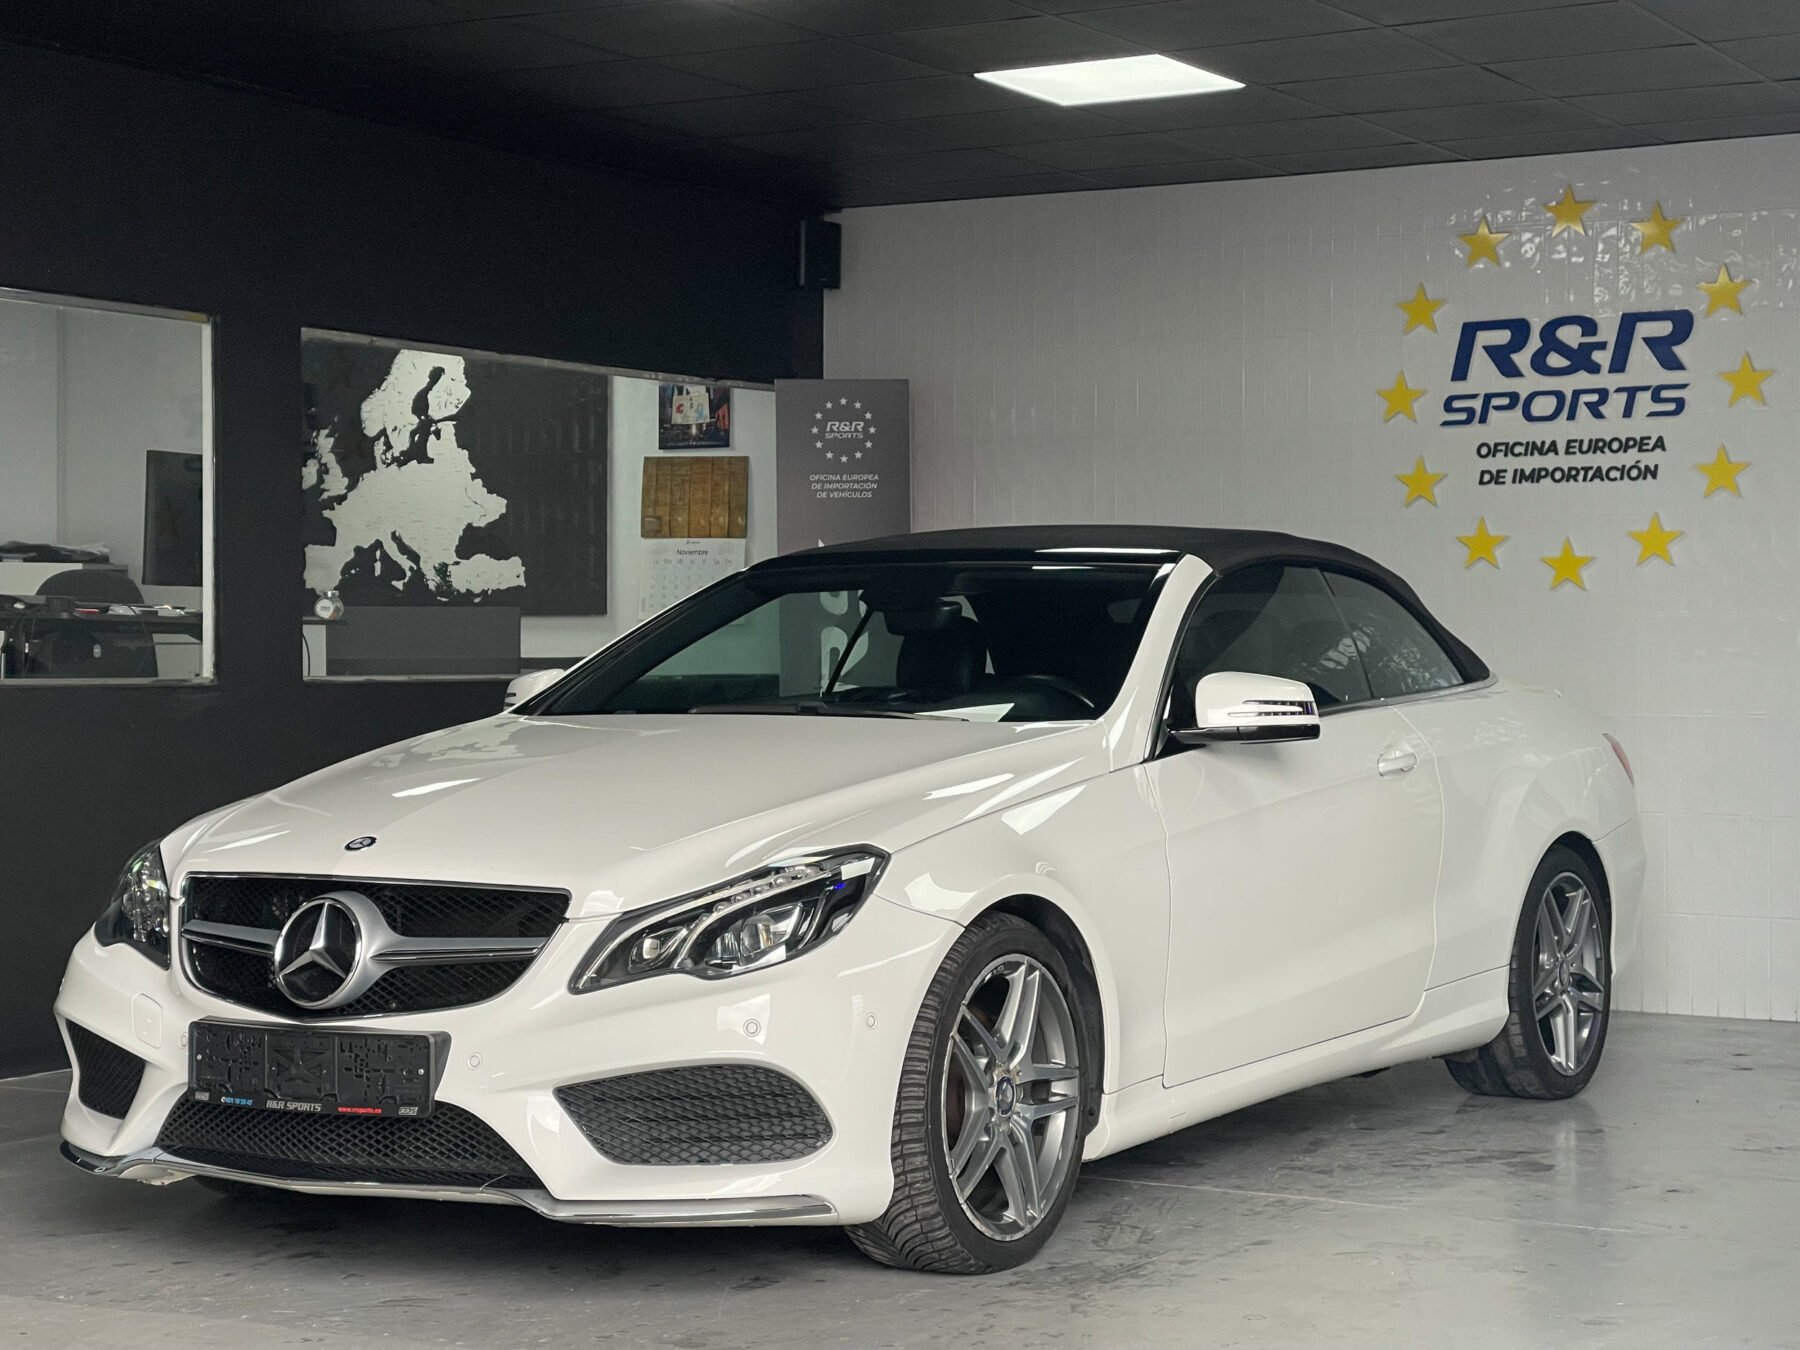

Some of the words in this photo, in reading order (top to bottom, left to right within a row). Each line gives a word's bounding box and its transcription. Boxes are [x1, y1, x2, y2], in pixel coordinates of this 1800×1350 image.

[1450, 308, 1694, 382] R&R
[1440, 382, 1690, 427] SPORTS
[826, 421, 865, 432] R&R
[1476, 440, 1560, 459] OFICINA
[1564, 436, 1667, 456] EUROPEA
[1478, 468, 1507, 486] DE
[1512, 460, 1660, 484] IMPORTACIÓN
[829, 490, 873, 498] VEHÍCULOS
[266, 1100, 284, 1110] R&R
[286, 1102, 322, 1112] SPORTS
